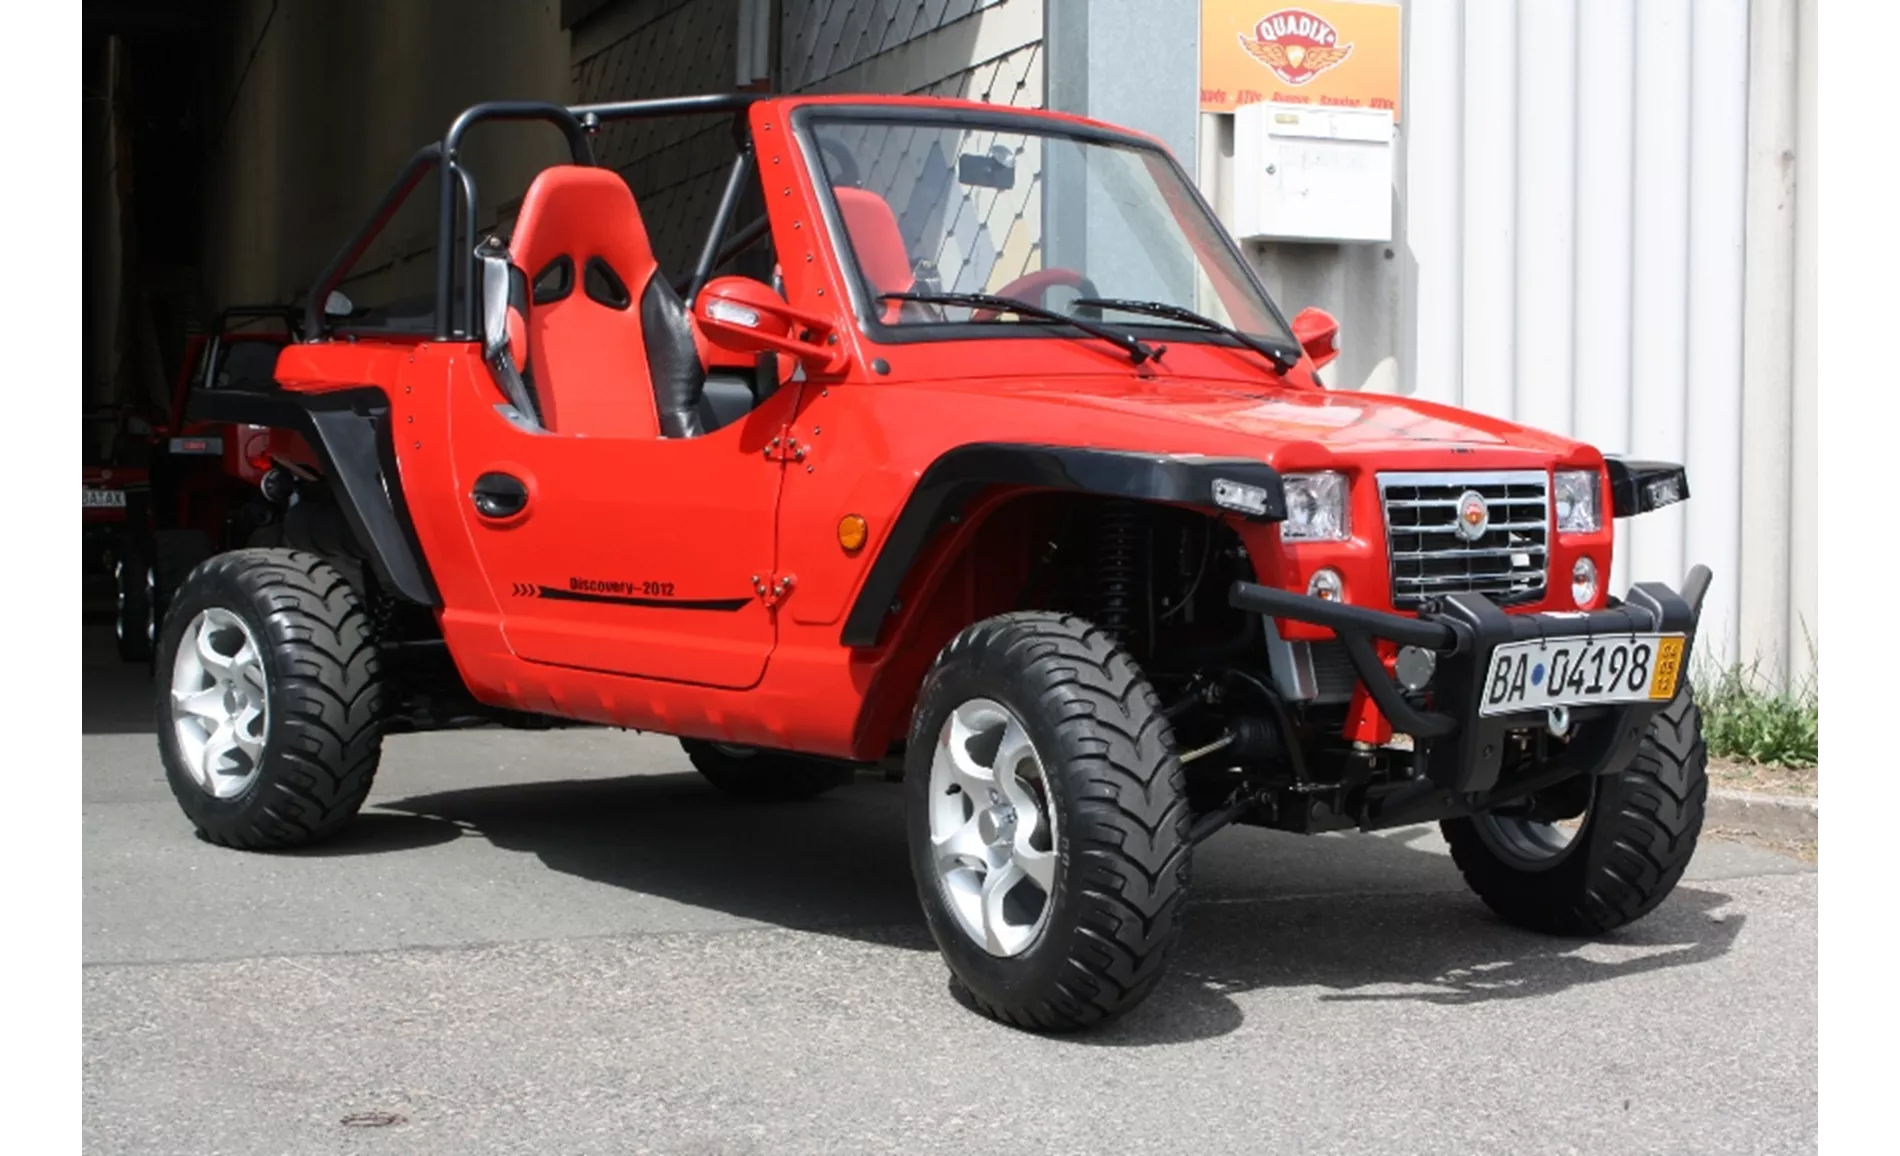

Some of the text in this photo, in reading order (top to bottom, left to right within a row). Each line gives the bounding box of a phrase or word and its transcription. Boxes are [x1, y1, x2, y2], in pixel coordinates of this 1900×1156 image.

[1260, 15, 1331, 44] QUADIX
[1489, 643, 1651, 704] BA 04198
